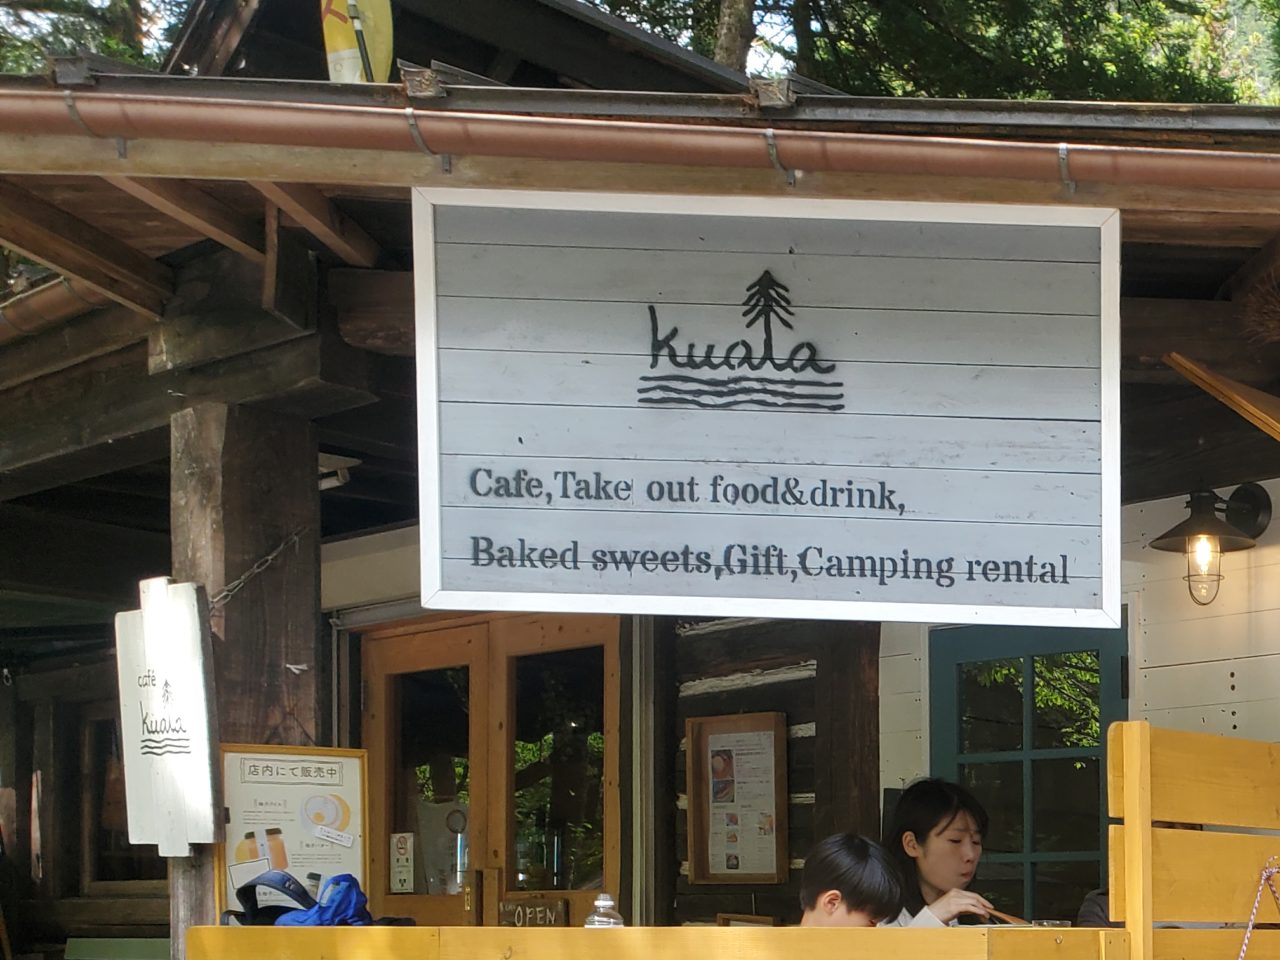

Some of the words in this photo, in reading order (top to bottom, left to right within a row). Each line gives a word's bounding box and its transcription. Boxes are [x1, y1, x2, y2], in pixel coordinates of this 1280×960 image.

[646, 474, 700, 504] out
[709, 474, 906, 516] food&drink,
[469, 537, 579, 571] Baked
[964, 553, 1070, 585] rental
[137, 669, 156, 688] café
[248, 764, 337, 779] 店内にて販売中
[514, 906, 556, 926] OPEN
